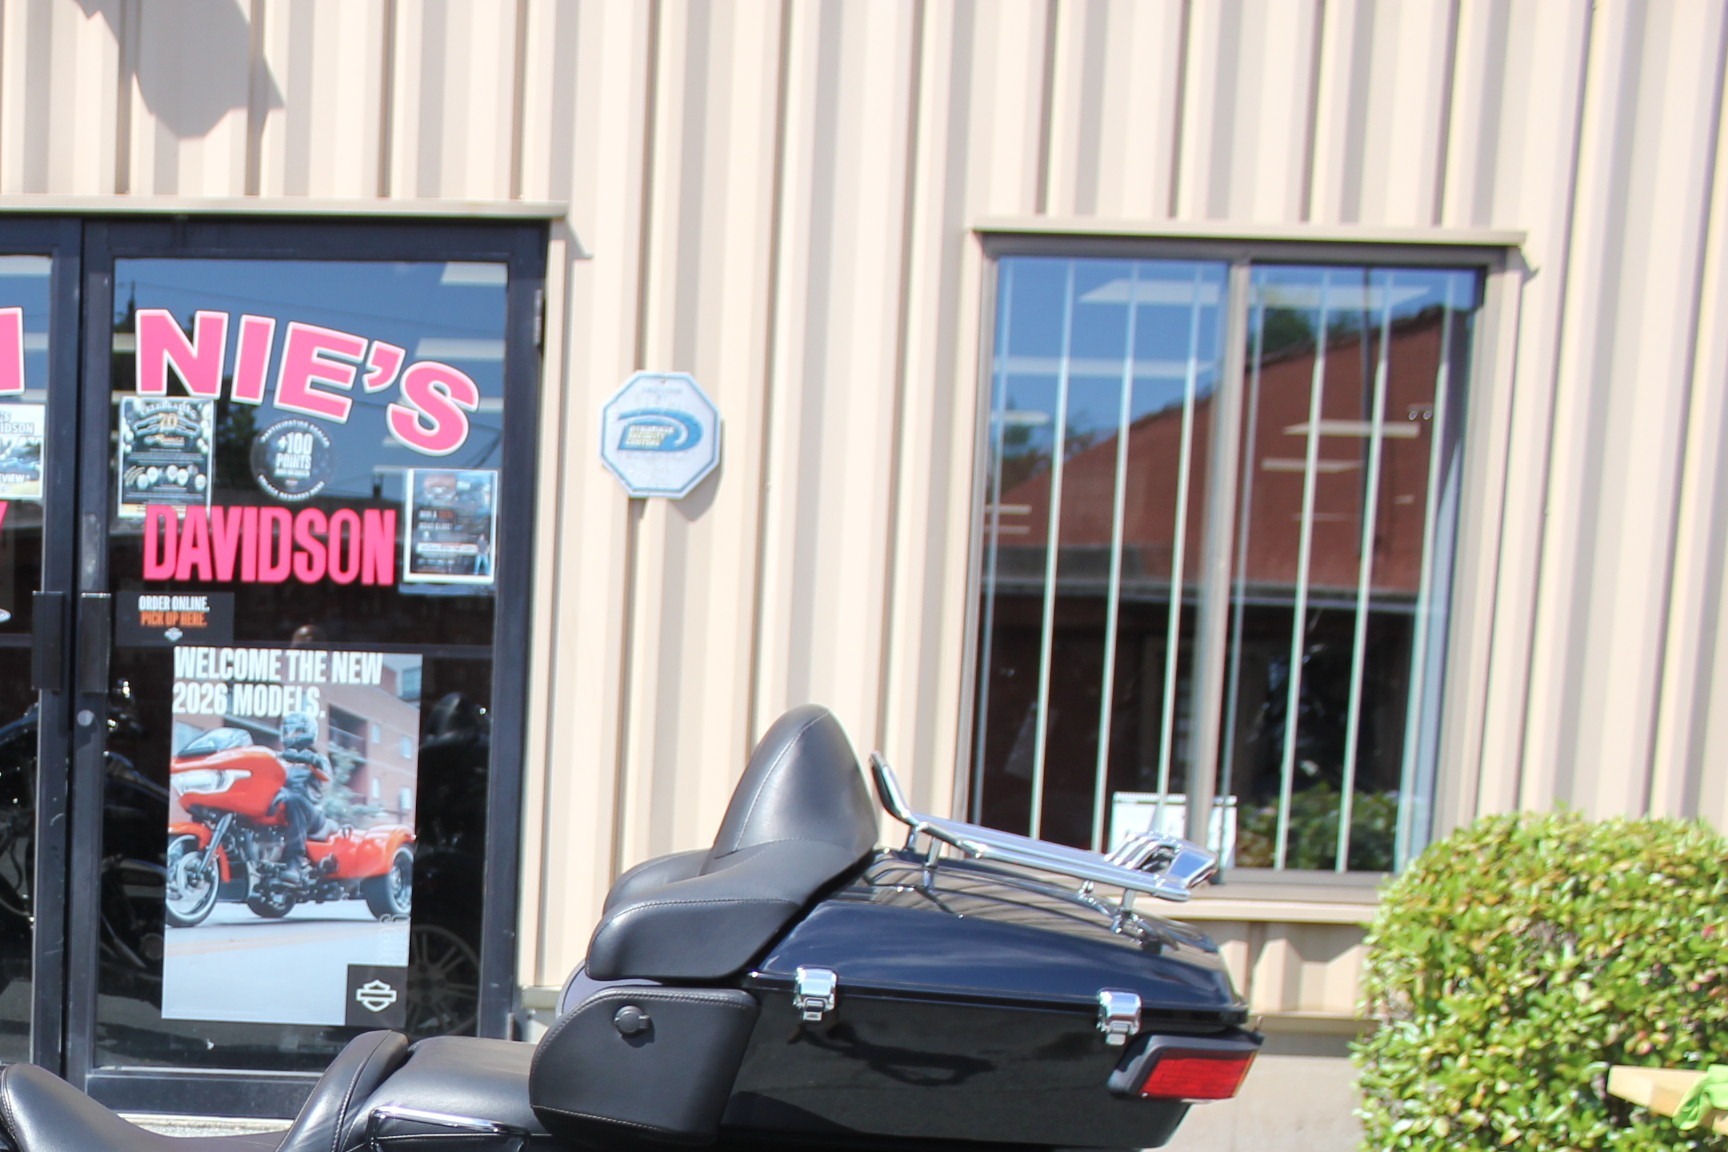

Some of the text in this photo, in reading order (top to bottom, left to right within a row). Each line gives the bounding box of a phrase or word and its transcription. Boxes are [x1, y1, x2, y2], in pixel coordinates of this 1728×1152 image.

[275, 453, 312, 470] POINTS
[143, 504, 396, 586] DAVIDSON
[138, 595, 210, 612] ORDER ONLINE.
[140, 611, 165, 626] PICK
[165, 611, 179, 627] UP
[174, 646, 383, 685] WELCOME THE NEW
[173, 682, 227, 716] 2026
